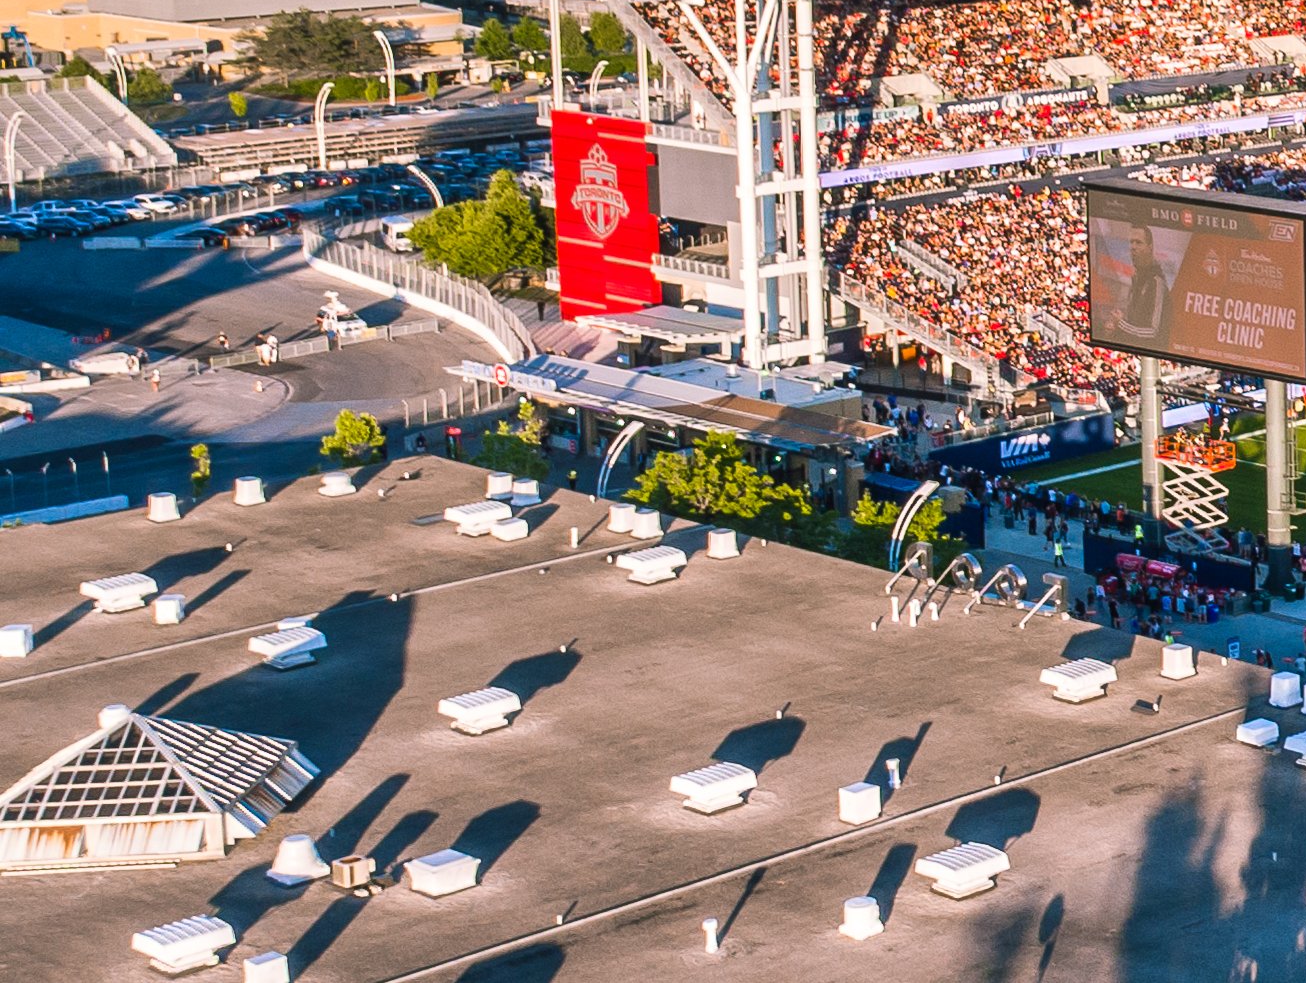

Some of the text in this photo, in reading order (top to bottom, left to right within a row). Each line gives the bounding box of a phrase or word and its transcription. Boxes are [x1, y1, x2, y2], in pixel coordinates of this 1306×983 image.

[947, 101, 999, 114] TORONTO
[1026, 90, 1088, 106] ARGONAUTS
[580, 187, 622, 204] TORONTO
[1152, 208, 1238, 230] BMO FIELD
[1230, 259, 1284, 279] COACHES
[1185, 291, 1297, 330] FREE COACHING
[1217, 322, 1265, 349] CLINIC
